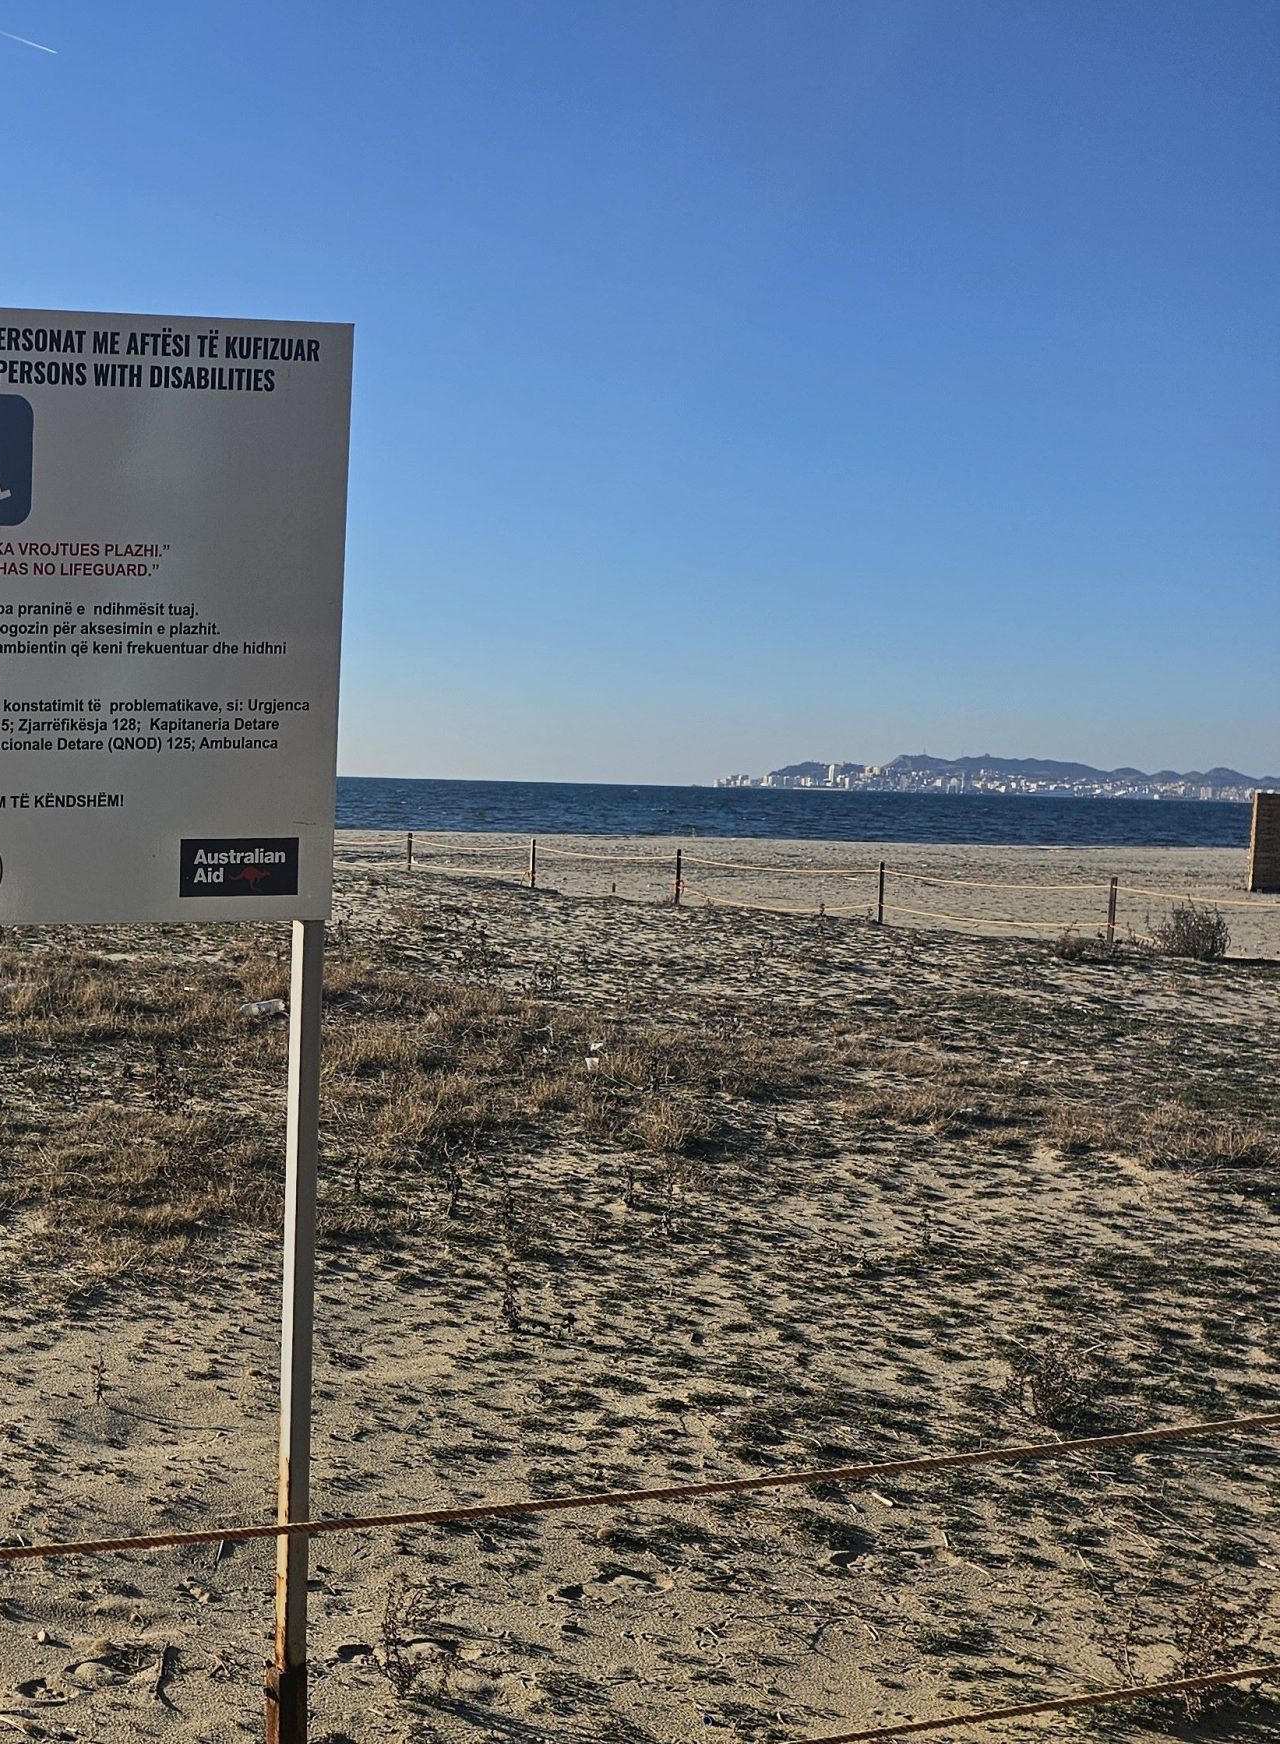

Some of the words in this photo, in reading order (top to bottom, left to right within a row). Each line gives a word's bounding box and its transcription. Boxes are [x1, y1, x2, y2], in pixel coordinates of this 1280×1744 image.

[92, 330, 120, 355] ME
[125, 327, 190, 357] AFTËSI
[196, 330, 219, 358] TË
[224, 335, 320, 362] KUFIZUAR
[93, 362, 142, 388] WITH
[149, 364, 275, 392] DISABILITIES
[17, 542, 100, 557] VROJTUES
[33, 562, 56, 576] NO
[17, 601, 72, 618] praninë
[76, 604, 85, 615] e
[93, 601, 165, 616] ndihmësit
[167, 602, 198, 619] tuaj.
[52, 620, 77, 638] për
[80, 621, 152, 635] aksesimin
[156, 624, 165, 635] e
[169, 621, 220, 638] plazhit.
[70, 640, 88, 657] që
[92, 640, 122, 654] keni
[125, 640, 209, 654] frekuentuar
[212, 641, 239, 654] dhe
[242, 641, 286, 654] hidhni
[3, 698, 84, 712] konstatimit
[87, 698, 101, 712] të
[109, 698, 222, 715] problematikave,
[226, 698, 243, 711] si:
[247, 698, 309, 714] Urgjenca
[17, 717, 107, 735] Zjarrëfikësja
[111, 717, 141, 733] 128;
[149, 717, 230, 733] Kapitaneria
[234, 717, 279, 730] Detare
[57, 737, 104, 750] Detare
[107, 735, 162, 753] (QNOD)
[166, 736, 195, 752] 125;
[198, 736, 278, 749] Ambulanca
[9, 792, 30, 809] TË
[34, 791, 124, 808] KËNDSHËM!
[193, 848, 286, 865] Australian
[193, 867, 224, 883] Aid
